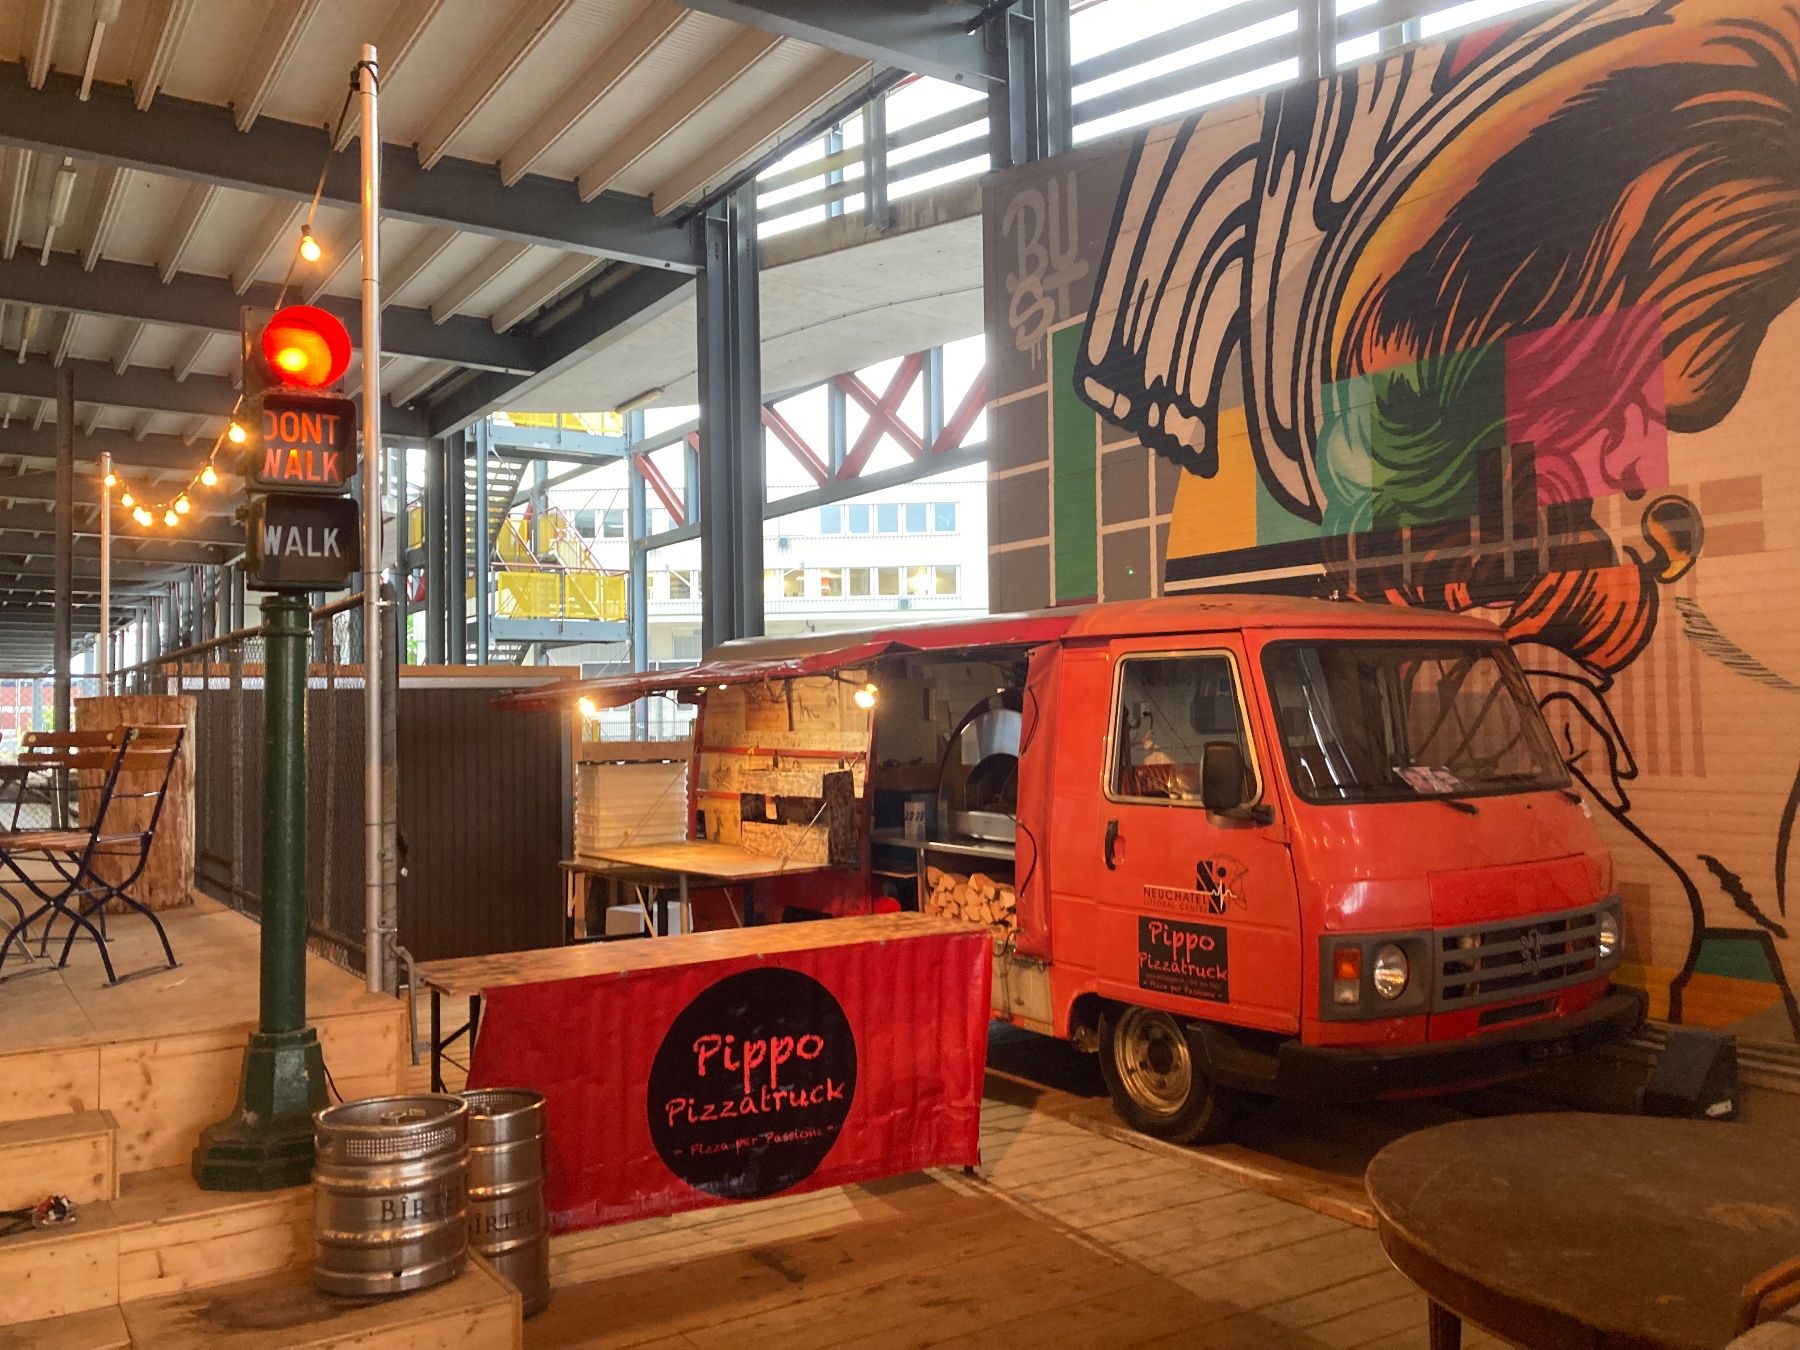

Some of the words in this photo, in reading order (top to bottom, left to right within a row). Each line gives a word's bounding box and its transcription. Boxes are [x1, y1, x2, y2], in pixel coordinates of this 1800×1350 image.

[263, 410, 341, 445] DONT
[262, 447, 342, 482] WALK
[264, 524, 342, 558] WALK
[1148, 921, 1215, 963] Pippo
[1139, 952, 1228, 981] Pizzatruck
[693, 1033, 824, 1094] Pippo
[665, 1077, 846, 1128] Pizzatruck
[690, 1139, 729, 1156] Pizza
[734, 1135, 759, 1155] per
